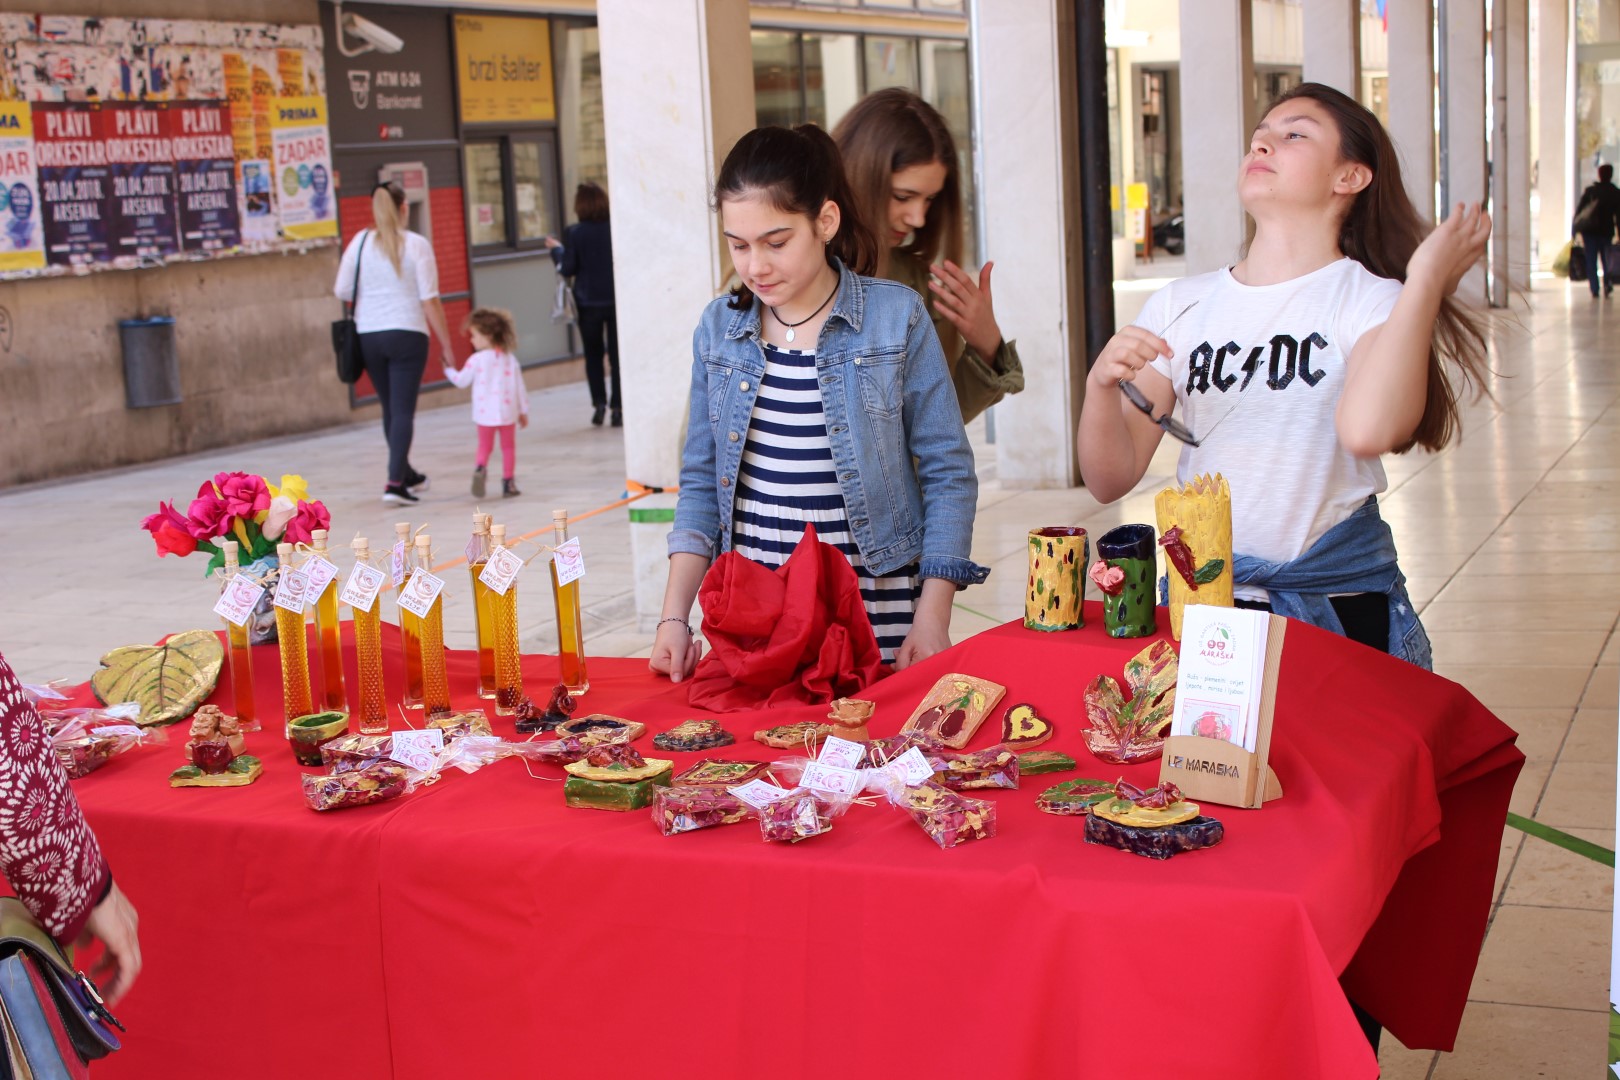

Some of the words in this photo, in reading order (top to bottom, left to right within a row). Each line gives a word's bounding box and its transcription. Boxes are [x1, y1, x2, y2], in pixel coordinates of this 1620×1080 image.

[376, 71, 399, 87] ATM
[401, 71, 421, 87] 0-24
[468, 54, 497, 81] brzi
[501, 54, 542, 82] šalter
[376, 94, 423, 110] Bankomat
[45, 111, 91, 137] PLAVI
[115, 110, 158, 135] PLAVI
[182, 109, 221, 133] PLAVI
[279, 106, 319, 121] PRIMA
[36, 140, 107, 166] ORKESTAR
[105, 137, 172, 163] ORKESTAR
[172, 135, 233, 160] ORKESTAR
[277, 137, 326, 165] ZADAR
[43, 178, 105, 201] 20.04.2018.
[113, 175, 170, 196] 20.04.2018.
[180, 171, 232, 192] 20.04.2018.
[53, 202, 101, 221] ARSENAL
[121, 197, 166, 216] ARSENAL
[187, 192, 229, 210] ARSENAL
[1200, 649, 1234, 660] MARAŠKA
